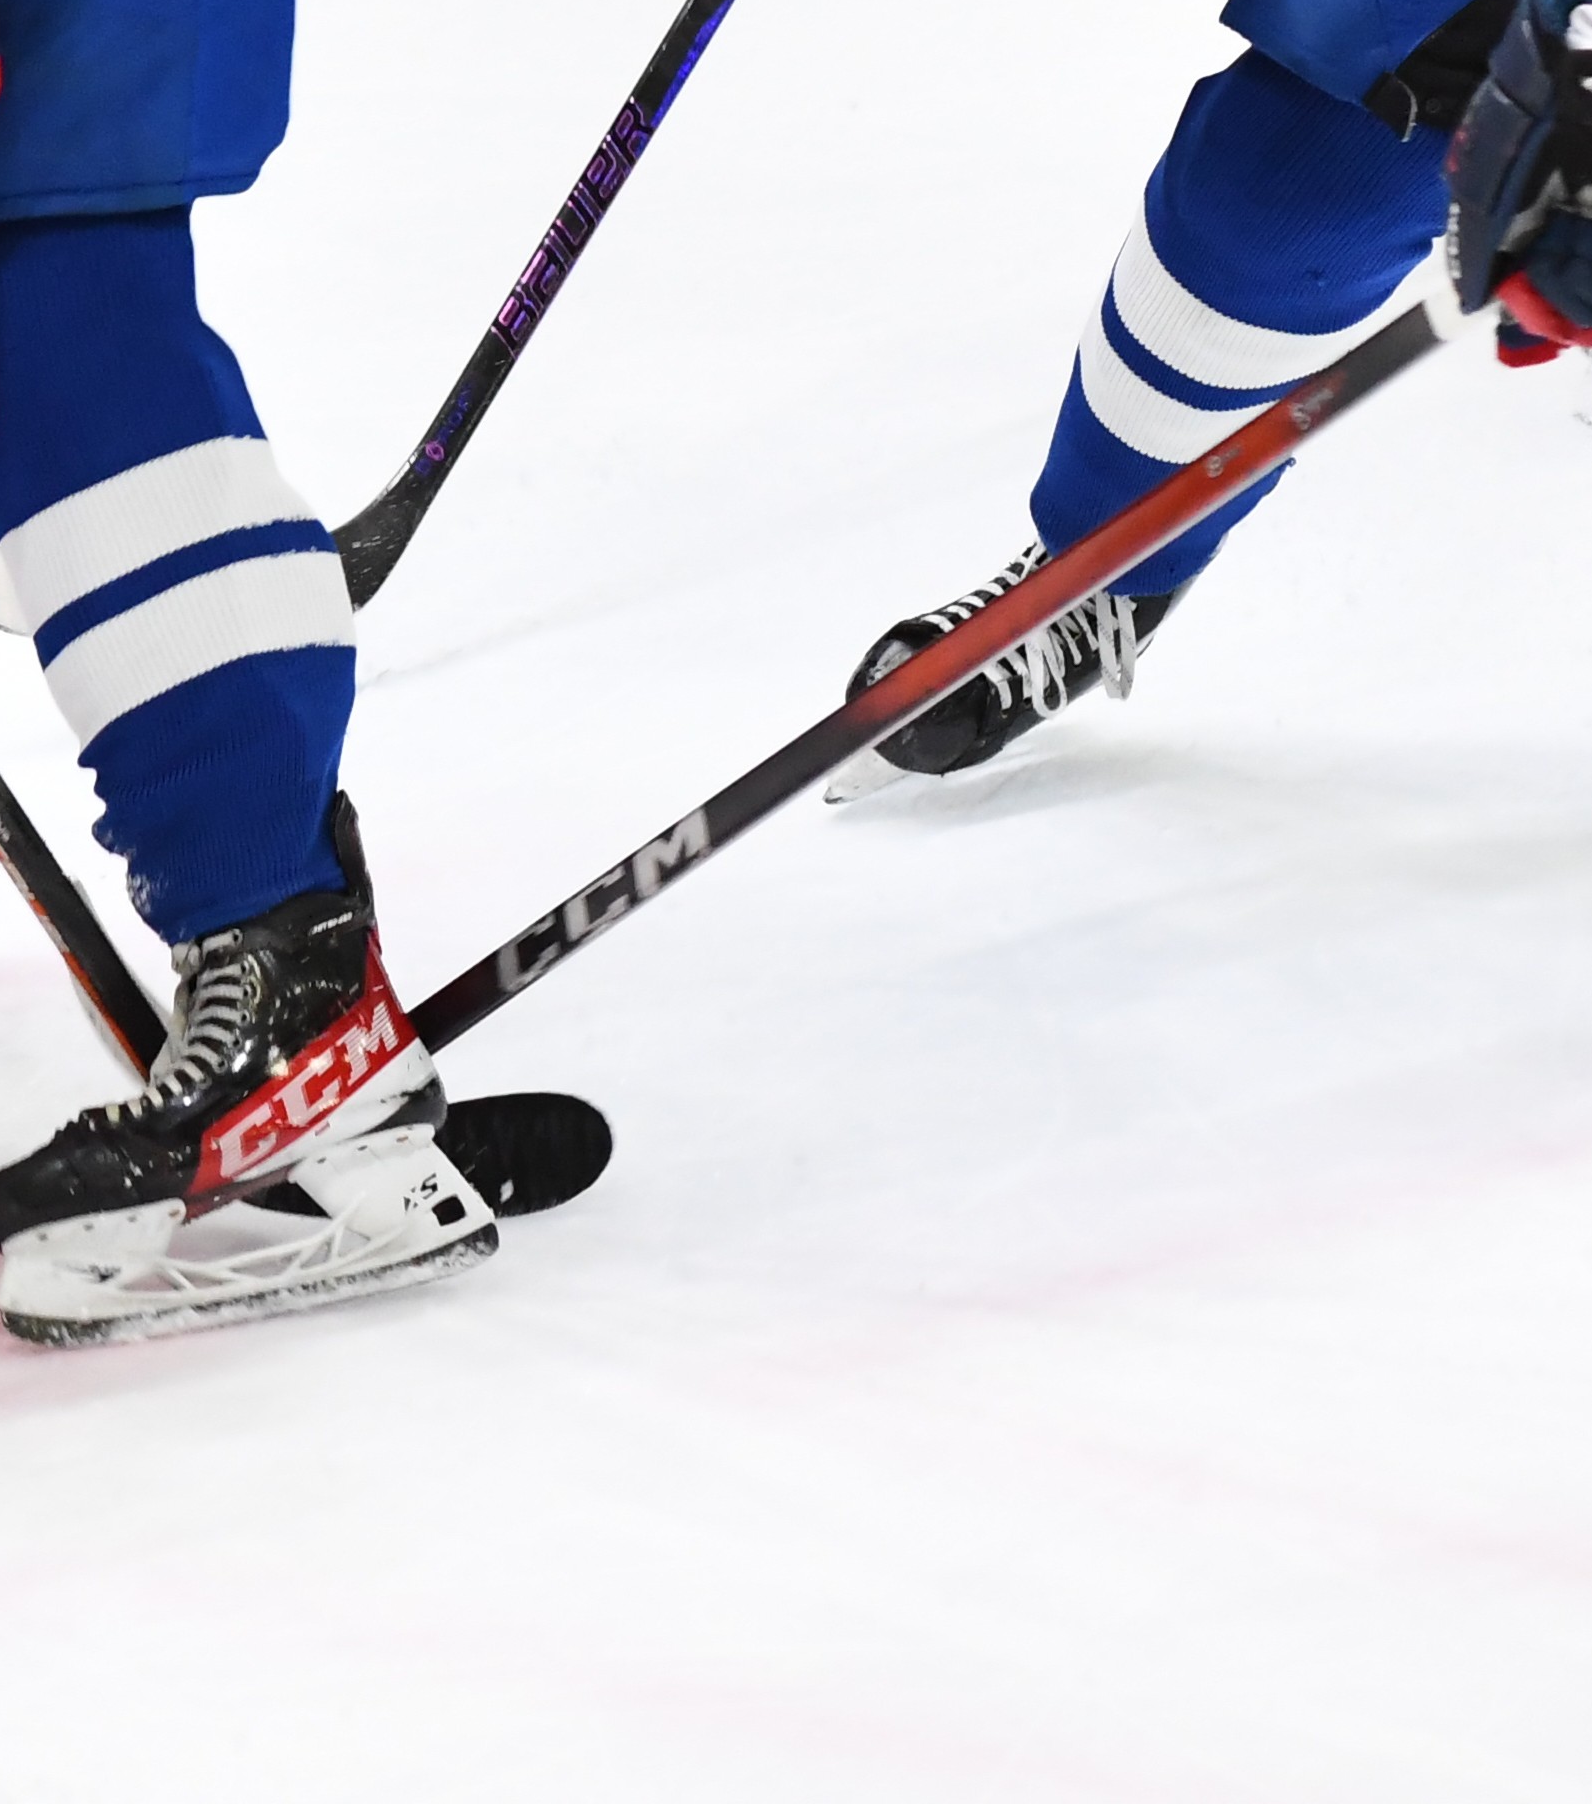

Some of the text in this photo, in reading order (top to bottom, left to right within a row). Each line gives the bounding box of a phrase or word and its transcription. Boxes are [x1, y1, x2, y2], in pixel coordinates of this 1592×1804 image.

[491, 95, 648, 361] BAUER
[497, 807, 711, 993] CCM
[211, 1001, 401, 1179] CCM
